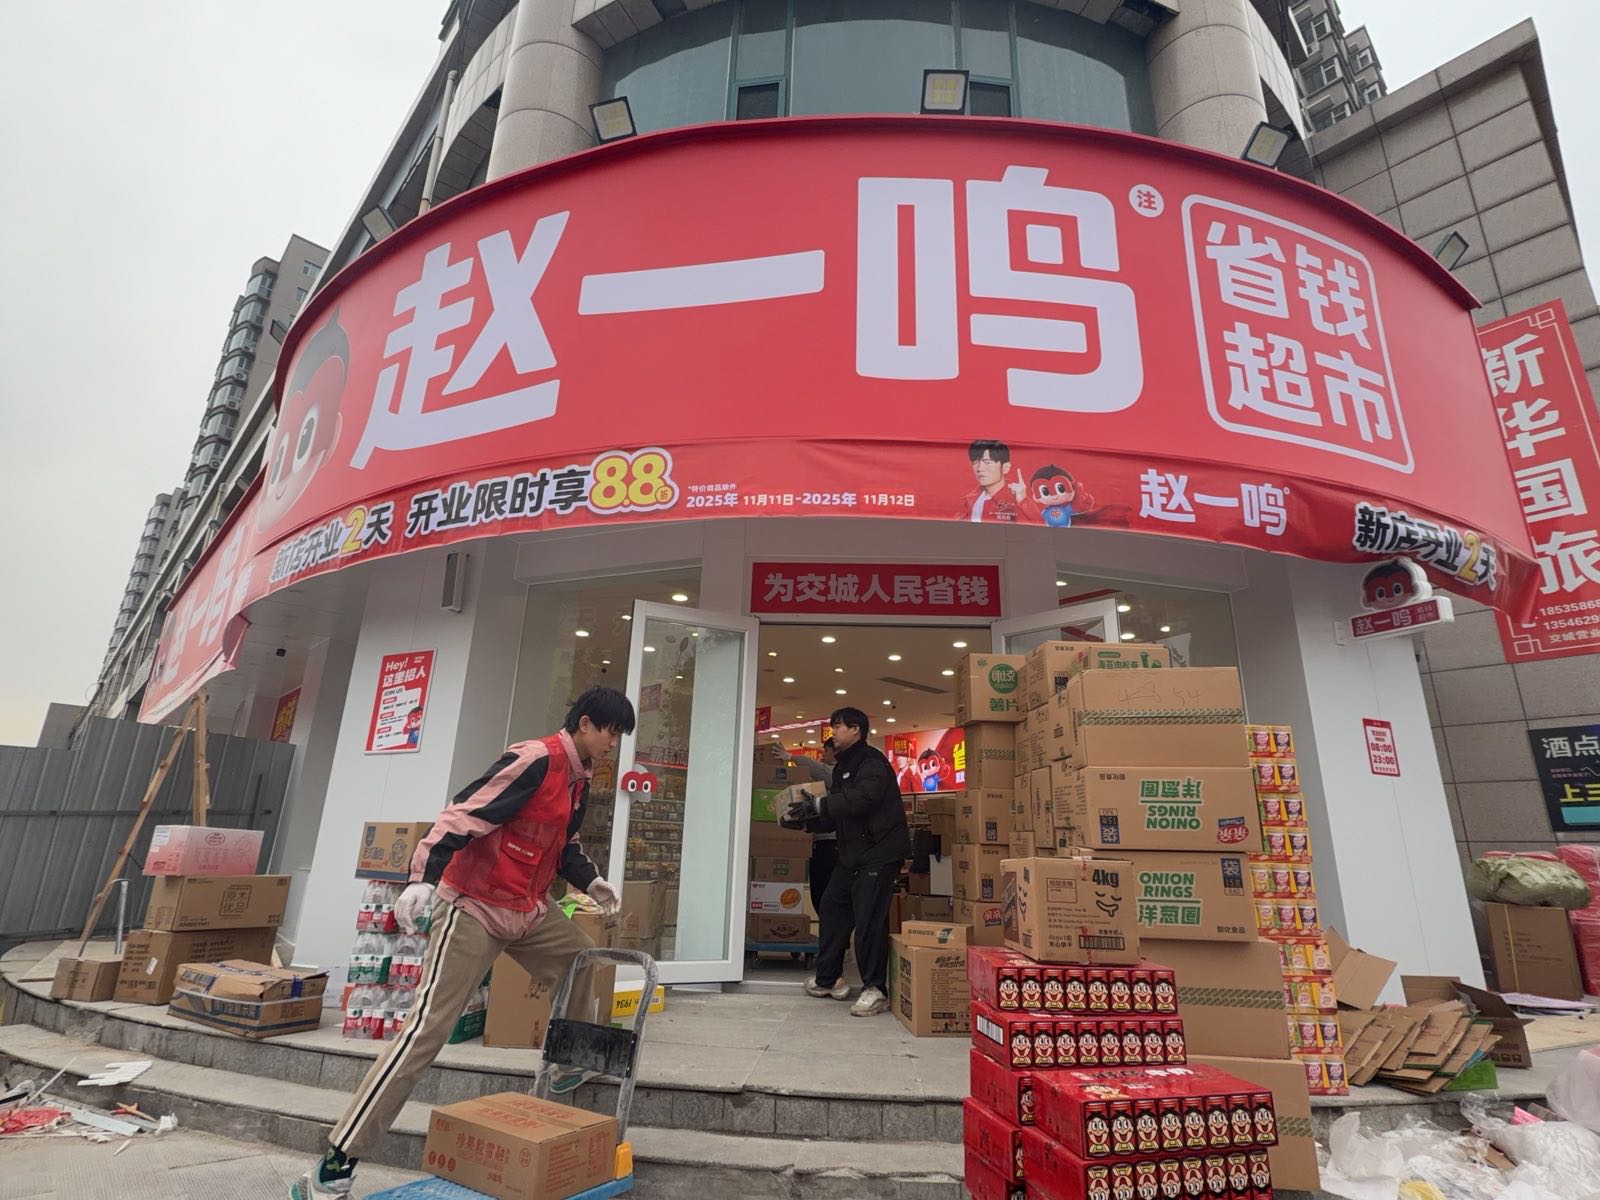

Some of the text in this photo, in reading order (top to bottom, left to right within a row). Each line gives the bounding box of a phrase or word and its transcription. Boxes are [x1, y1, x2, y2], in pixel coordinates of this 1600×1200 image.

[1206, 221, 1372, 350] 省钱
[350, 165, 1144, 470] 赵一鸣
[1223, 321, 1393, 443] 超市
[1139, 468, 1288, 536] 赵一鸣
[271, 502, 395, 581] 新店开业2天
[1354, 502, 1498, 591] 新店开业2天
[763, 572, 990, 606] 为交城人民省钱
[1356, 608, 1413, 635] 赵一鸣
[1543, 614, 1600, 630] 1354629
[1370, 742, 1393, 754] 08:00
[1372, 754, 1395, 766] 23:00
[1141, 777, 1202, 799] 洋葱圈
[1148, 805, 1197, 817] RINGS
[1146, 817, 1201, 830] ONION
[1092, 869, 1119, 888] 4kg
[1139, 872, 1195, 885] ONION
[1144, 885, 1194, 898] RINGS
[1138, 904, 1201, 927] 洋葱圈
